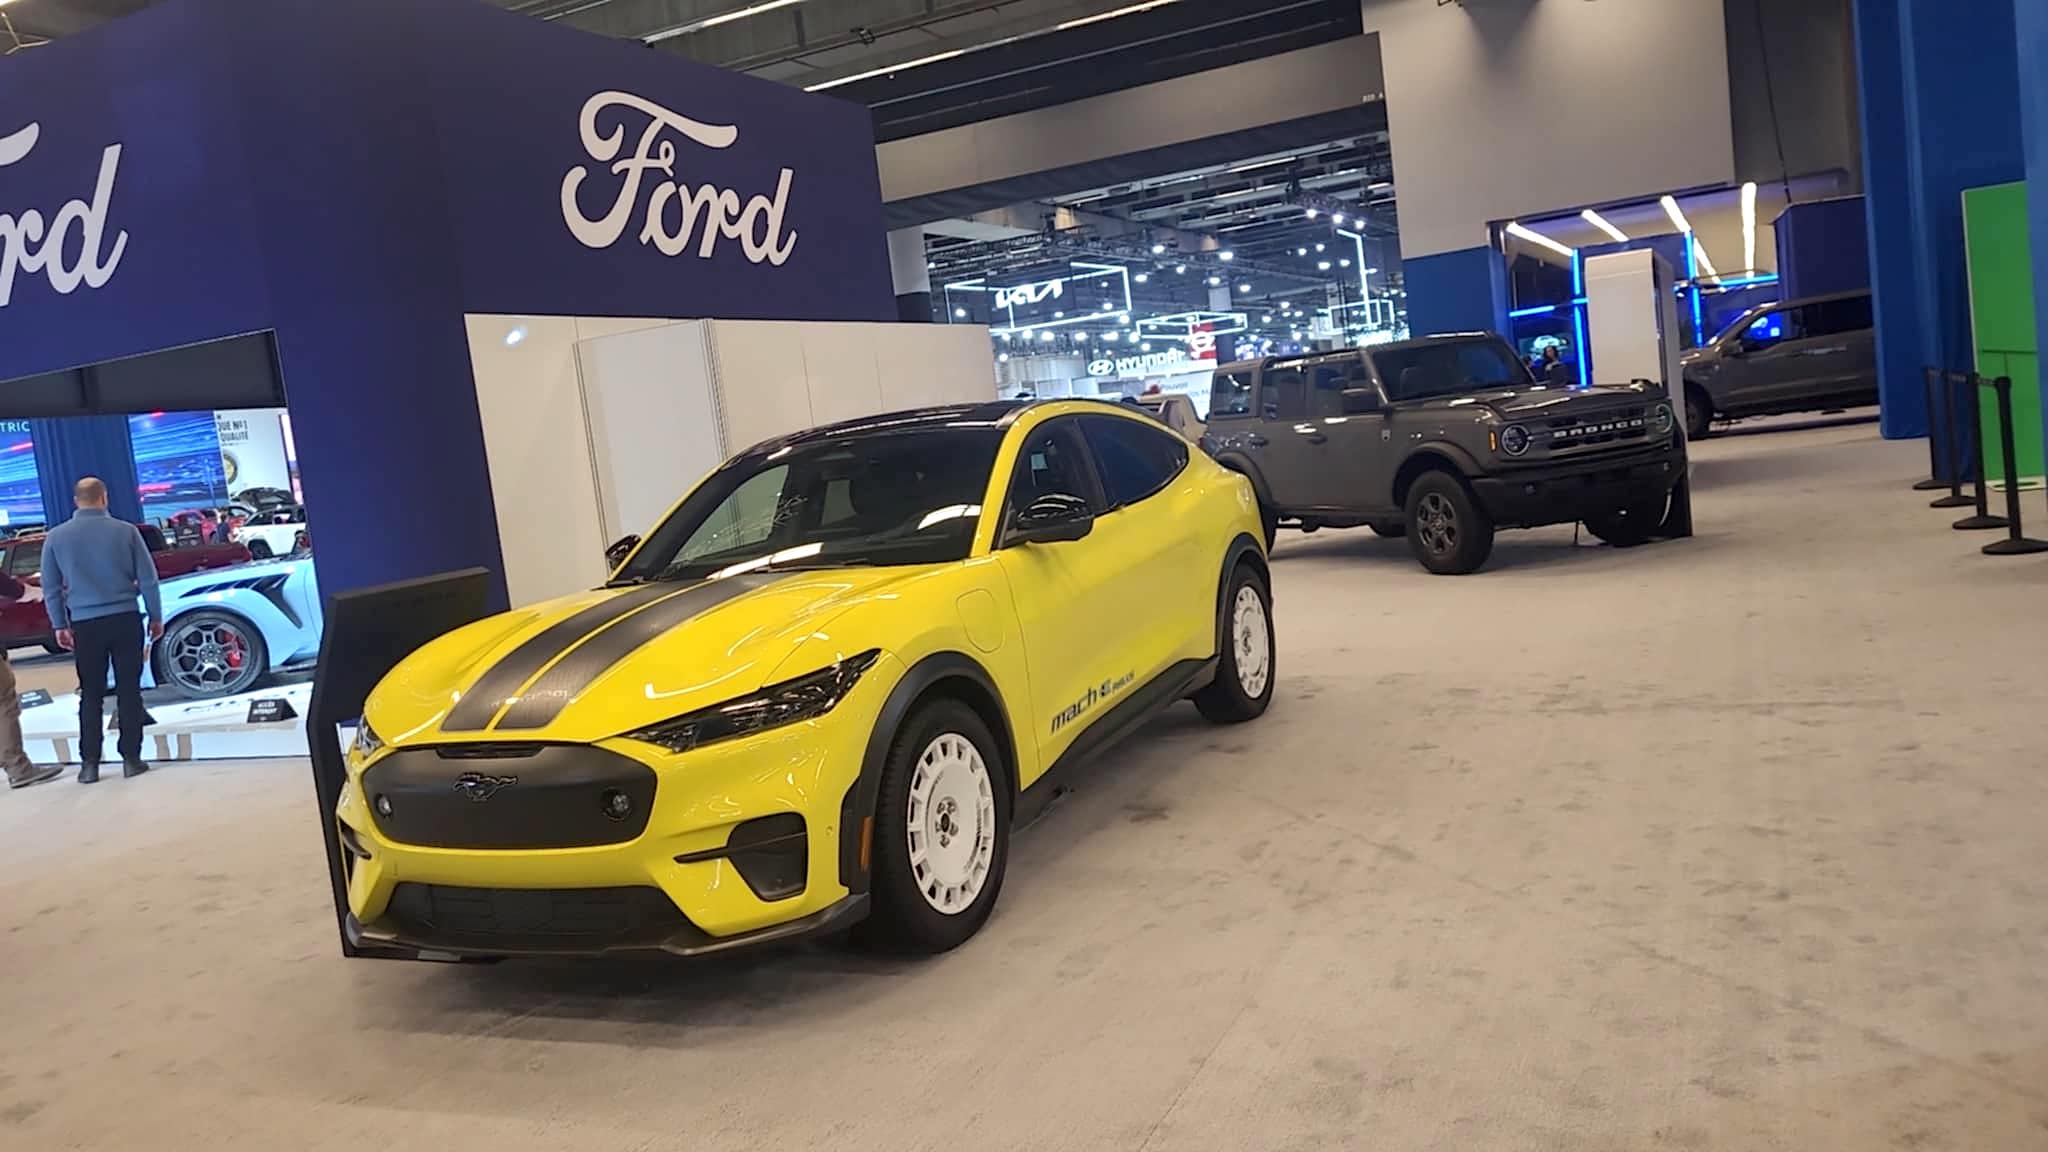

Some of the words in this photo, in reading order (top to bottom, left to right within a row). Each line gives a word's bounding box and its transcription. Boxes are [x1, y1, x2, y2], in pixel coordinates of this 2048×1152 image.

[561, 91, 797, 266] Ford
[0, 121, 128, 307] rd
[995, 279, 1063, 309] KIA
[1115, 348, 1186, 373] HYUNDAI
[1553, 419, 1642, 438] BRONCO
